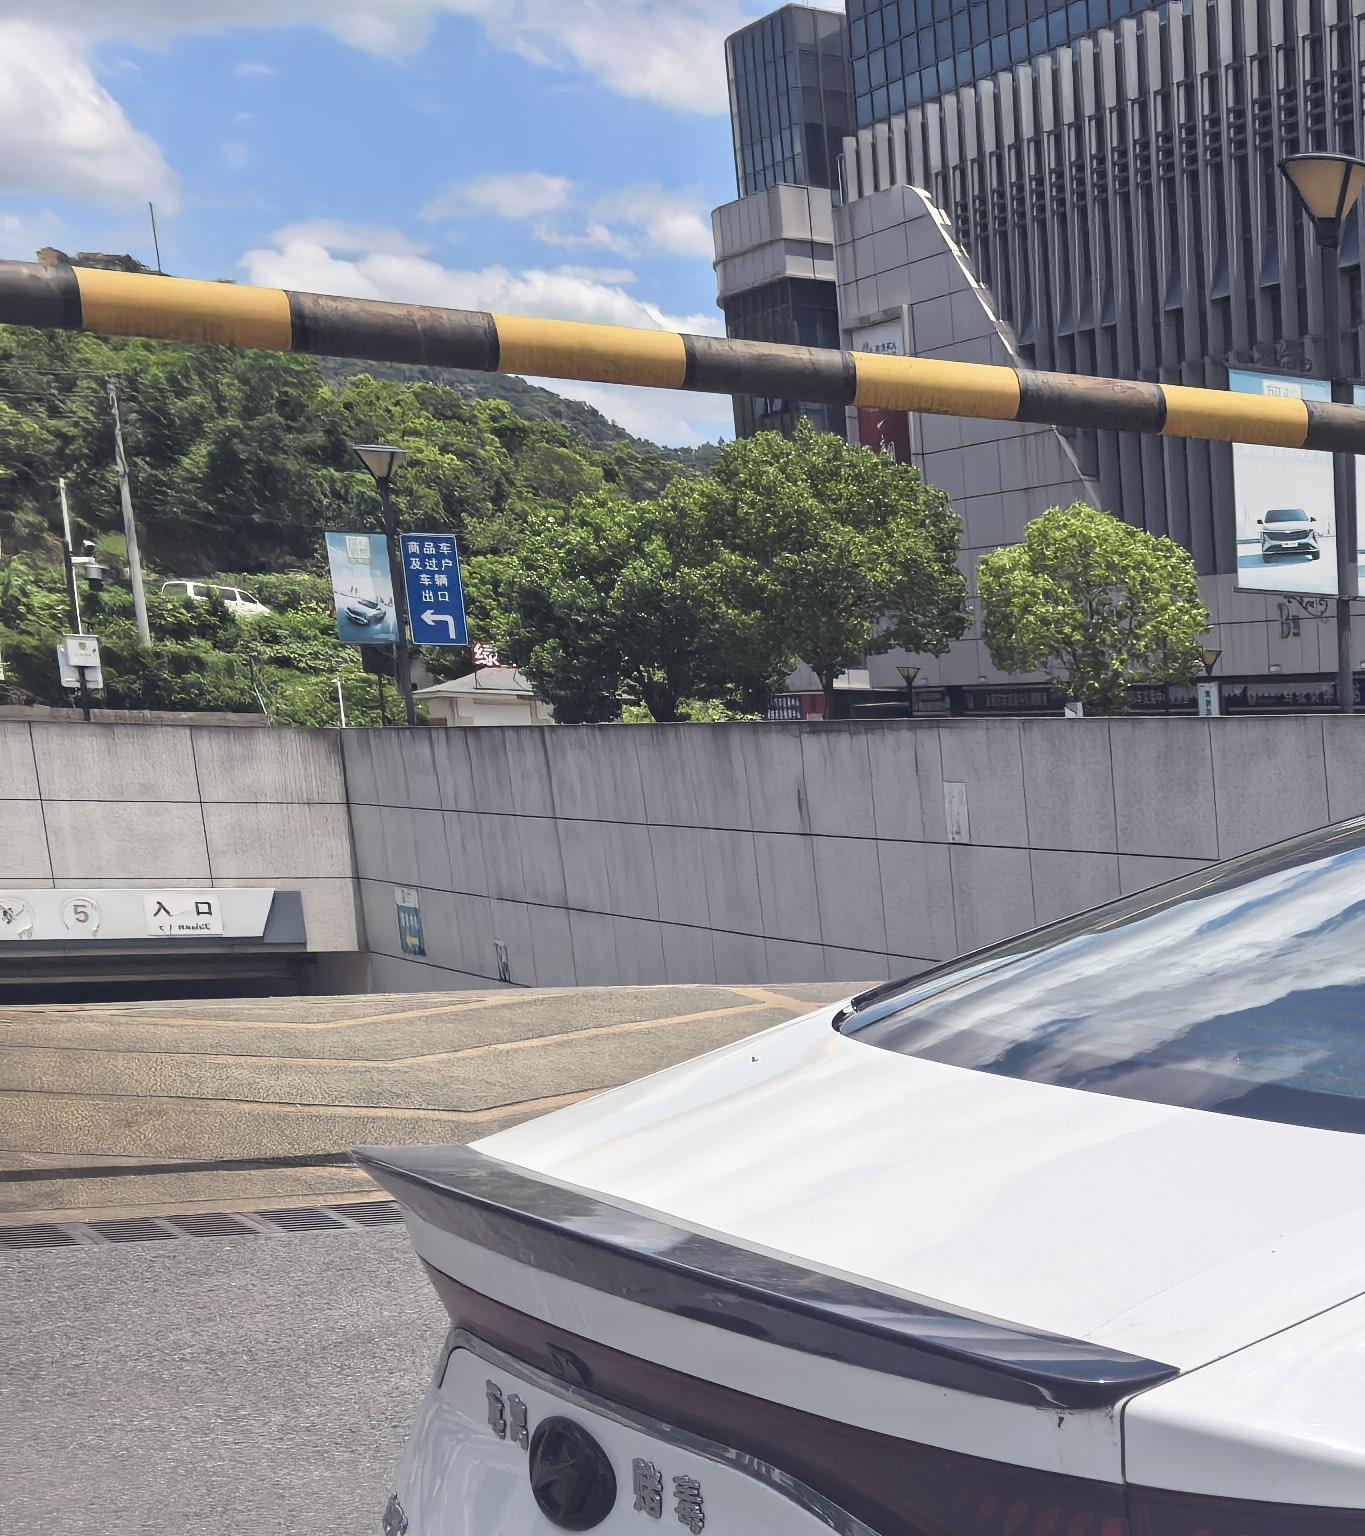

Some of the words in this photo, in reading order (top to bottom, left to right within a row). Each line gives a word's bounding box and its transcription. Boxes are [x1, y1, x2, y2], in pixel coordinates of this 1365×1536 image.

[407, 542, 452, 555] 商品车
[409, 558, 453, 571] 及过户
[419, 574, 448, 586] 车辆
[422, 590, 449, 602] 出口
[153, 900, 213, 916] 入口
